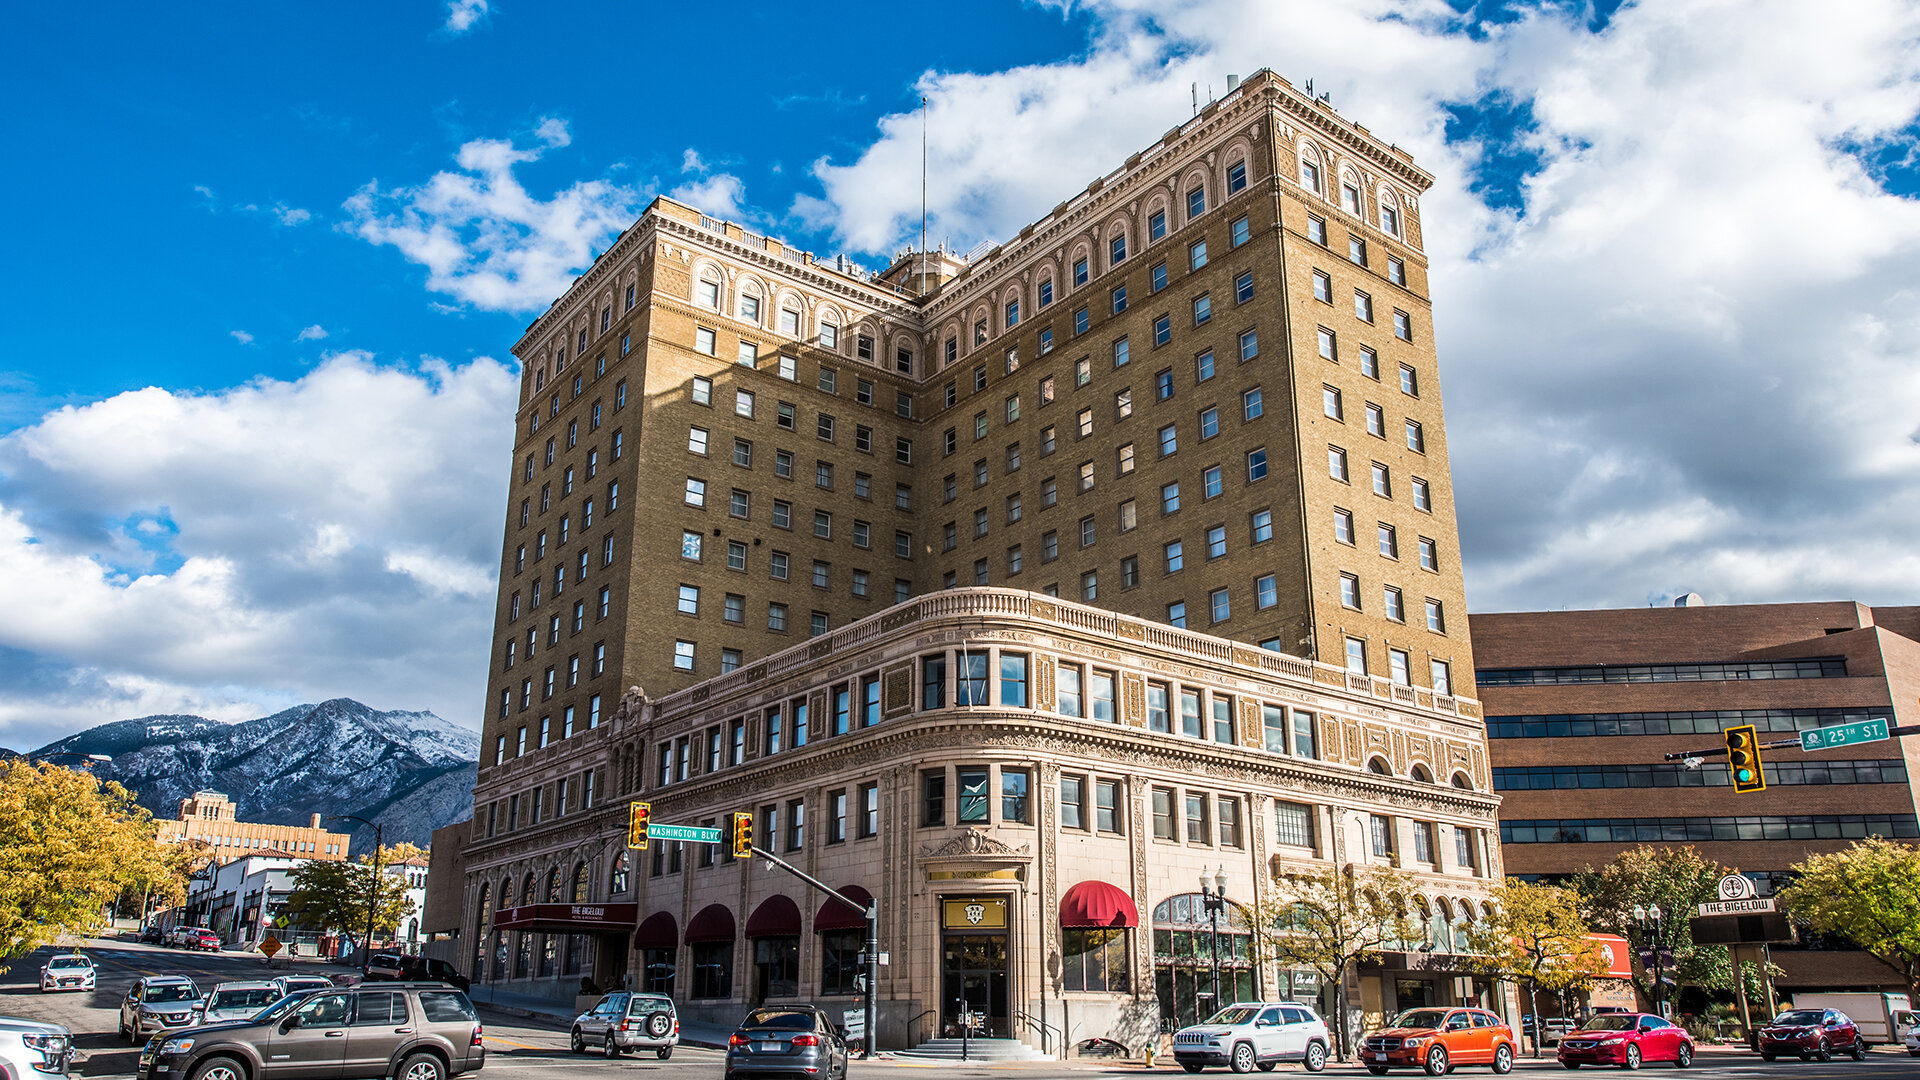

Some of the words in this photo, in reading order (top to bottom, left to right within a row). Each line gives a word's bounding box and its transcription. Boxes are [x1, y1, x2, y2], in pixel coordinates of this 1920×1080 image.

[1828, 728, 1856, 743] 25TH
[1863, 724, 1883, 738] ST.
[650, 827, 697, 838] WASHINGTON
[571, 905, 581, 914] THE
[581, 906, 604, 916] BIGELOW
[1705, 903, 1723, 913] THE
[1724, 900, 1768, 912] BIGELOW
